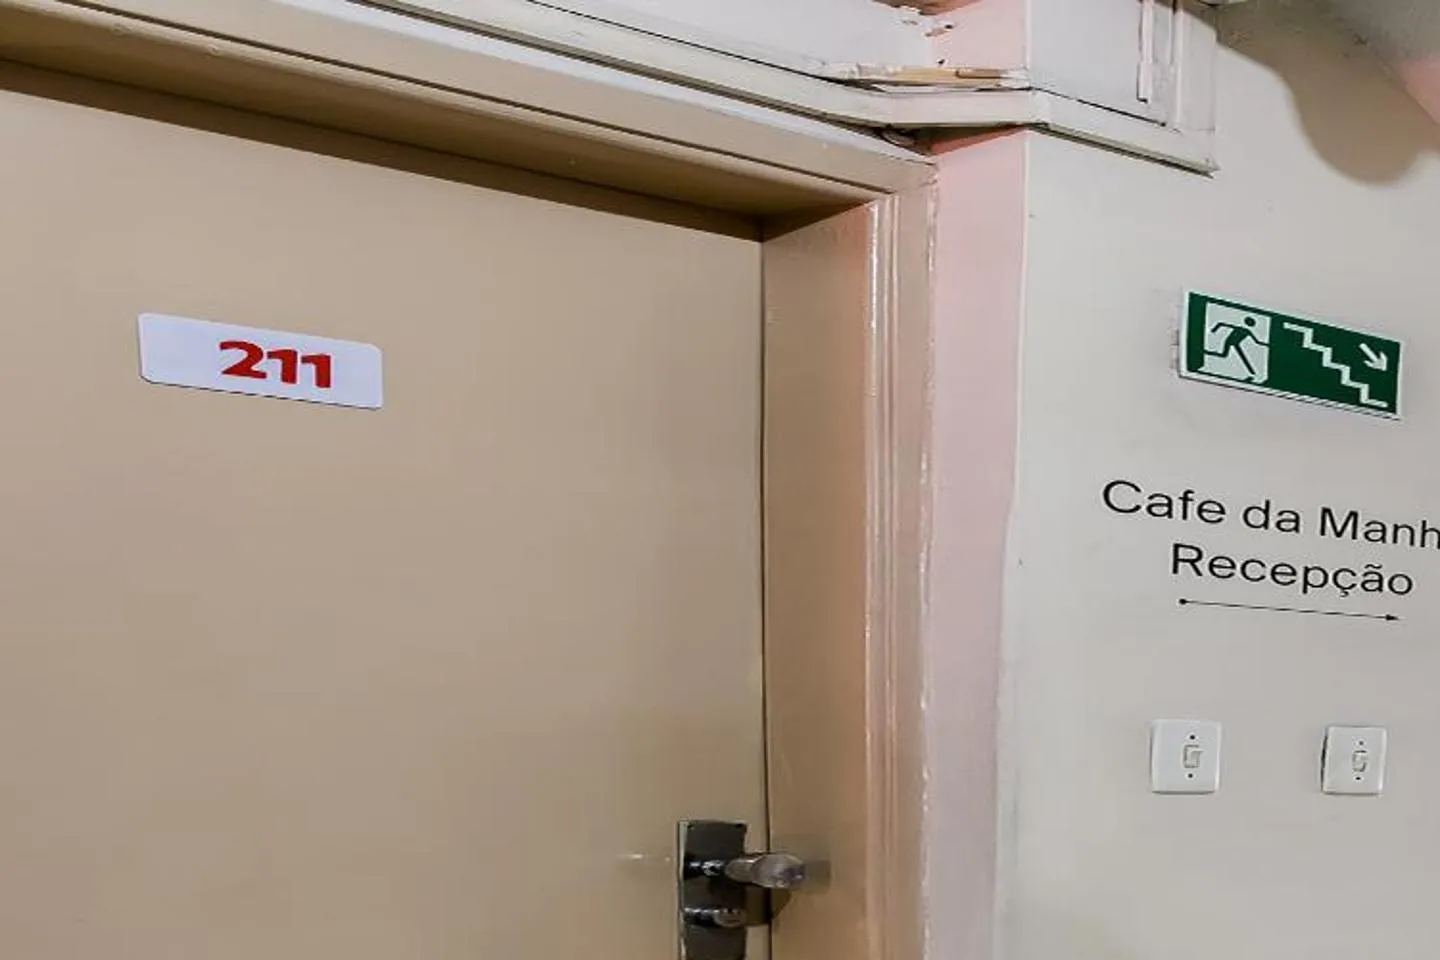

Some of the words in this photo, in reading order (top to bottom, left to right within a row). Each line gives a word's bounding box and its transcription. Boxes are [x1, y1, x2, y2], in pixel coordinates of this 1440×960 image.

[219, 340, 331, 388] 211
[1102, 479, 1226, 525] Cafe
[1243, 499, 1300, 534] da
[1172, 544, 1413, 597] Recepção
